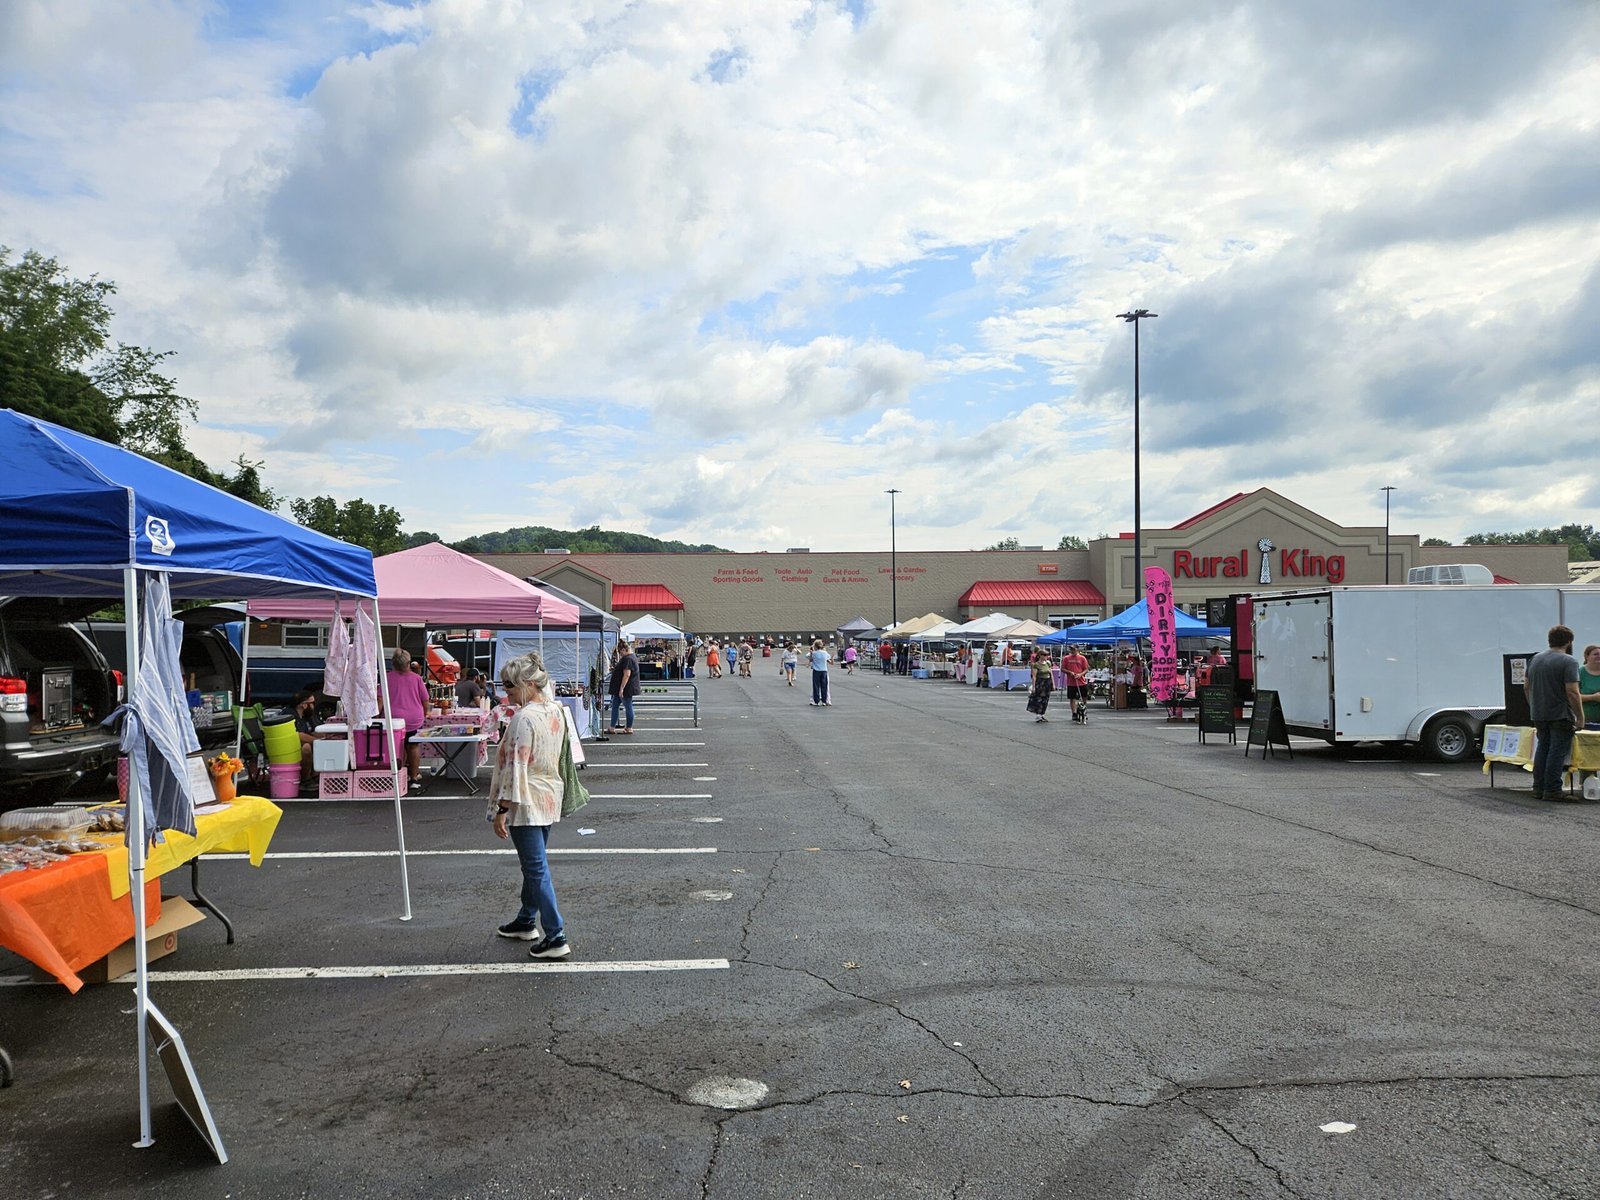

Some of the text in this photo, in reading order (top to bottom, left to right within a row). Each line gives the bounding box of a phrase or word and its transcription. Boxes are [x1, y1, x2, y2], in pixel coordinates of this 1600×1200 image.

[1174, 549, 1345, 583] Rural King
[1154, 593, 1171, 657] DIRTY
